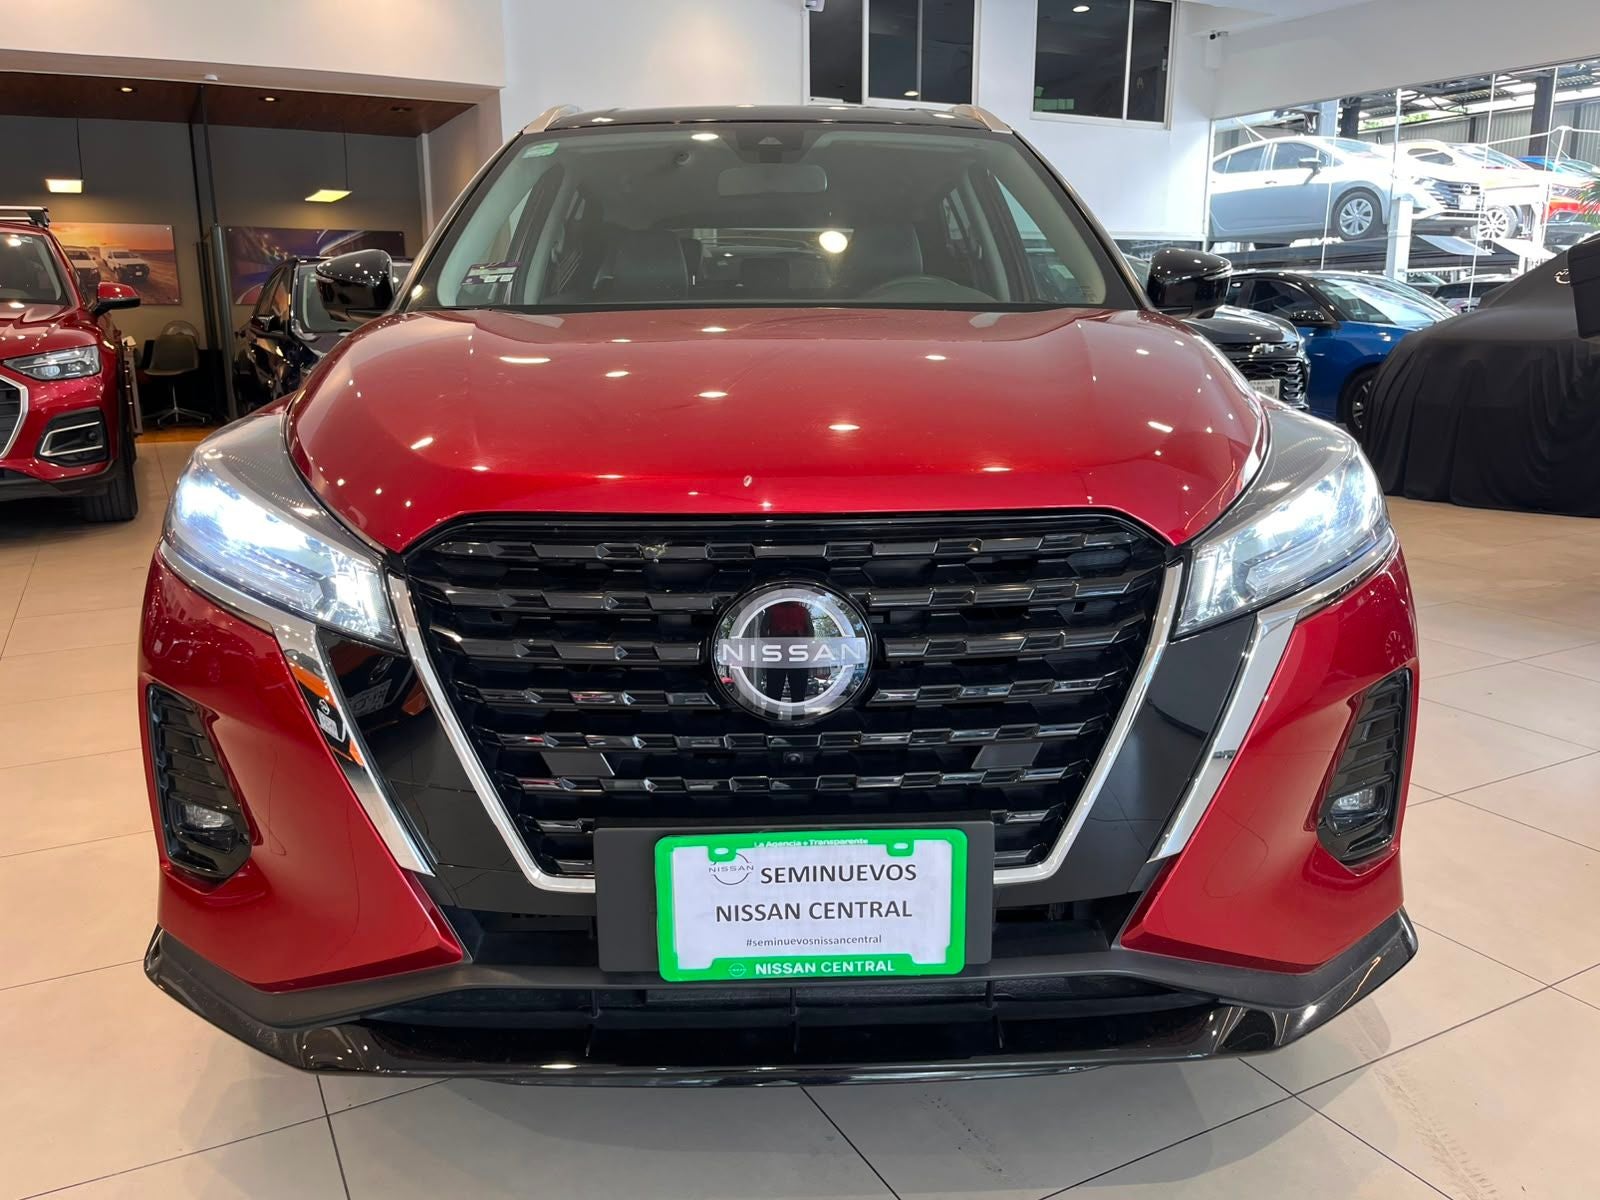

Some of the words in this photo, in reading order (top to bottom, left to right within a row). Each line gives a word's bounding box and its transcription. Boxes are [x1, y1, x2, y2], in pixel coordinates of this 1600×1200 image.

[722, 644, 861, 662] NISSAN
[708, 864, 755, 873] NISSAN
[760, 864, 917, 884] SEMINUEVOS
[716, 902, 801, 922] NISSAN
[808, 900, 913, 920] CENTRAL
[746, 934, 882, 947] #seminuevosnissancentral
[755, 962, 817, 975] NISSAN
[820, 960, 896, 973] CENTRAL
